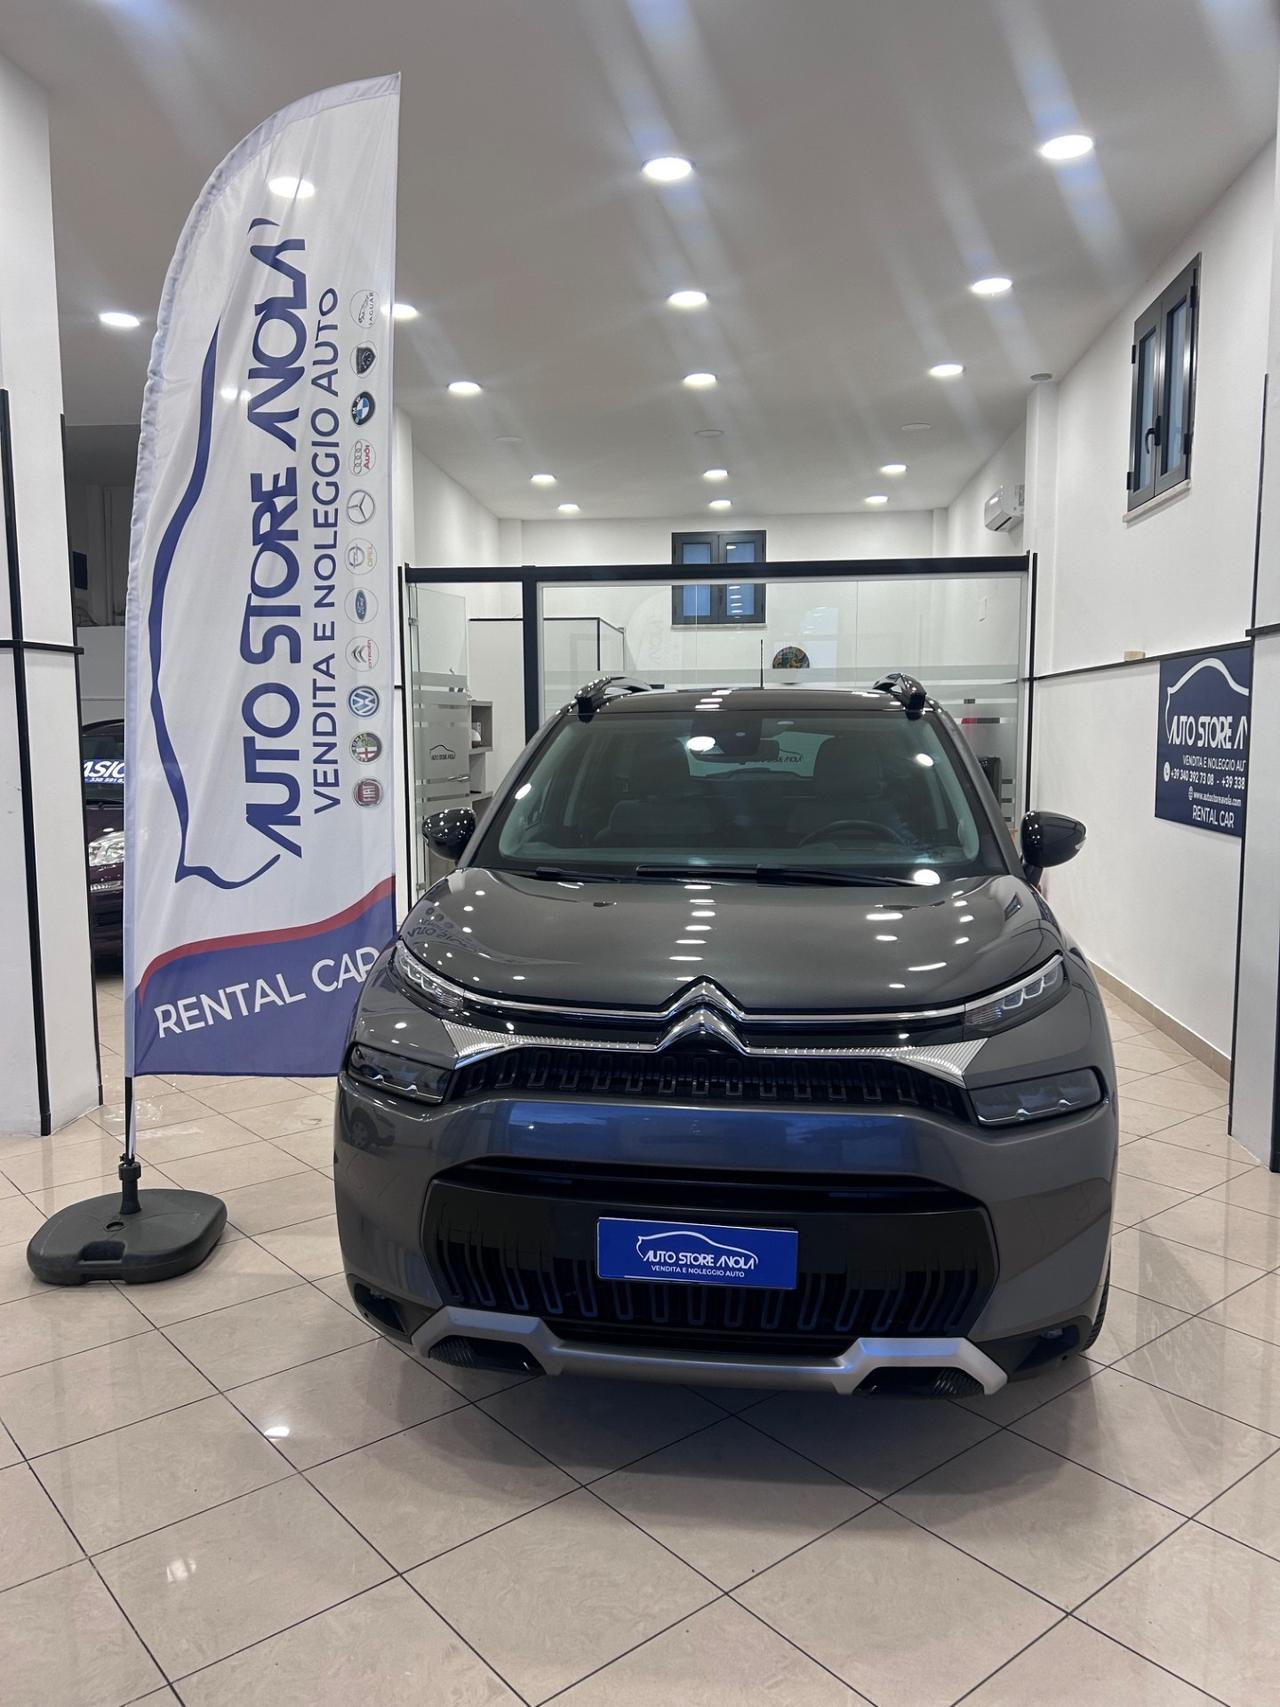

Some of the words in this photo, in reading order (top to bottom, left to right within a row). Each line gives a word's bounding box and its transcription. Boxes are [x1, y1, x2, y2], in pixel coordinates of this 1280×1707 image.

[311, 288, 338, 397] AUTO
[311, 408, 340, 608] NOLEGGIO
[240, 467, 302, 664] STORE
[313, 621, 335, 641] E
[312, 653, 341, 814] VENDITA
[1168, 715, 1196, 745] AUTO
[1197, 715, 1232, 749] STORE
[242, 682, 302, 858] AUTO
[1171, 768, 1180, 780] +39
[1189, 770, 1199, 784] 392
[1200, 772, 1207, 785] 73
[1222, 776, 1233, 788] +39
[1233, 777, 1246, 790] 338
[1183, 755, 1202, 768] VENDITA
[1203, 757, 1207, 768] E
[1208, 758, 1236, 771] NOLEGGIO
[1192, 804, 1218, 825] RENTAL
[1219, 810, 1235, 829] CAR
[154, 973, 306, 1038] RENTAL
[643, 1250, 676, 1264] AUTO
[678, 1252, 714, 1267] STORE
[651, 1265, 681, 1273] VENDITA
[688, 1267, 725, 1276] NOLEGGIO
[725, 1270, 745, 1278] AUTO
